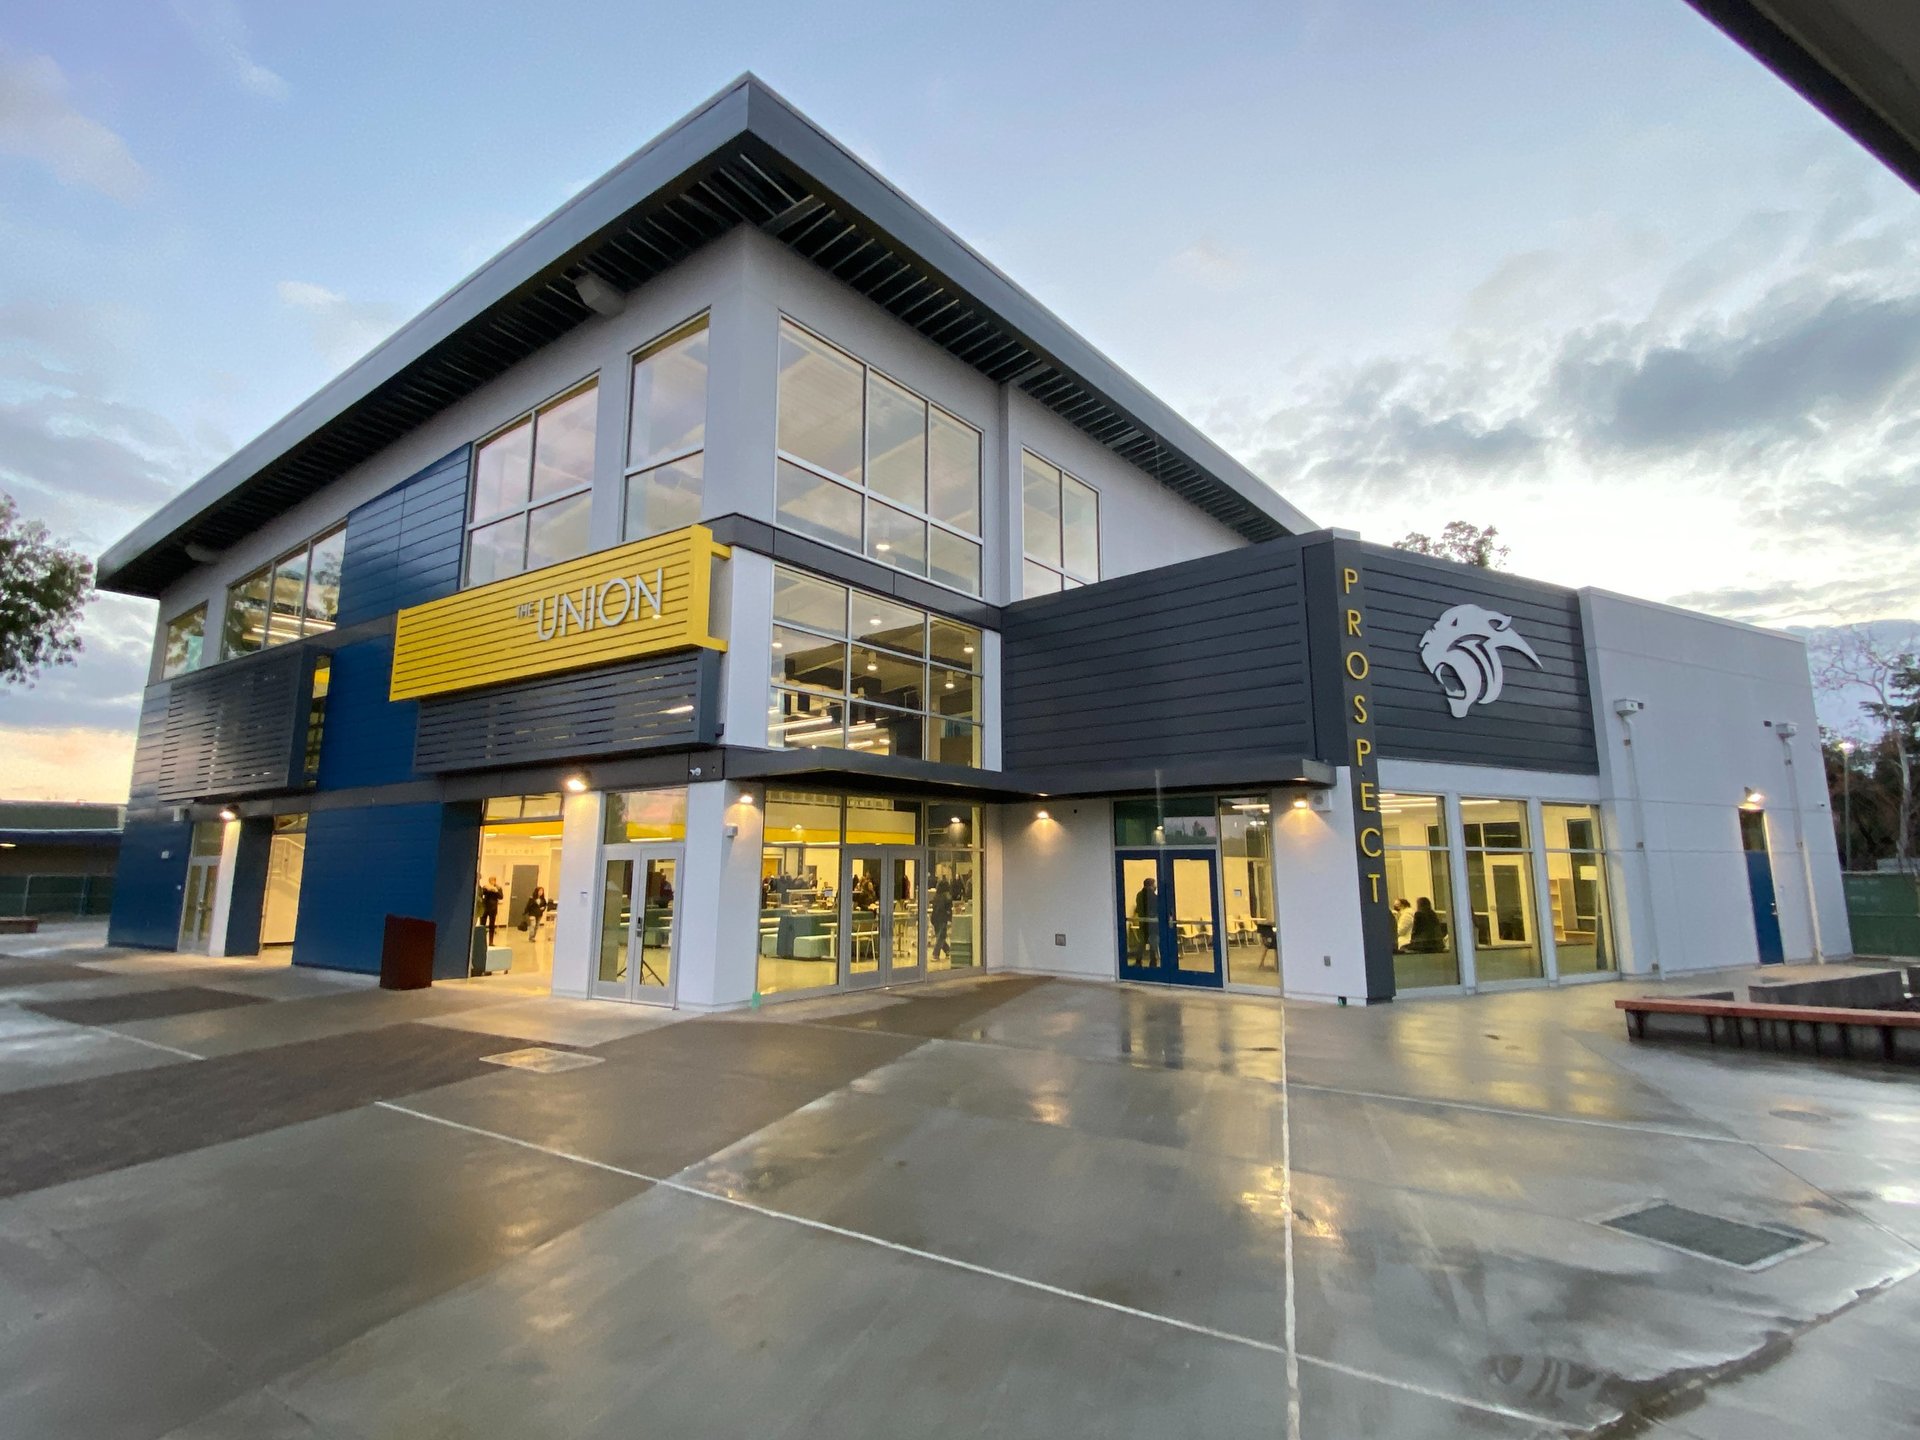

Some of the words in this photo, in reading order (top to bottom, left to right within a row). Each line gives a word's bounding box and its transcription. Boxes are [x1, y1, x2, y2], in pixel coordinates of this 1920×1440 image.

[516, 602, 535, 619] THE
[537, 567, 663, 641] UNION
[1343, 567, 1382, 904] PROSPECT
